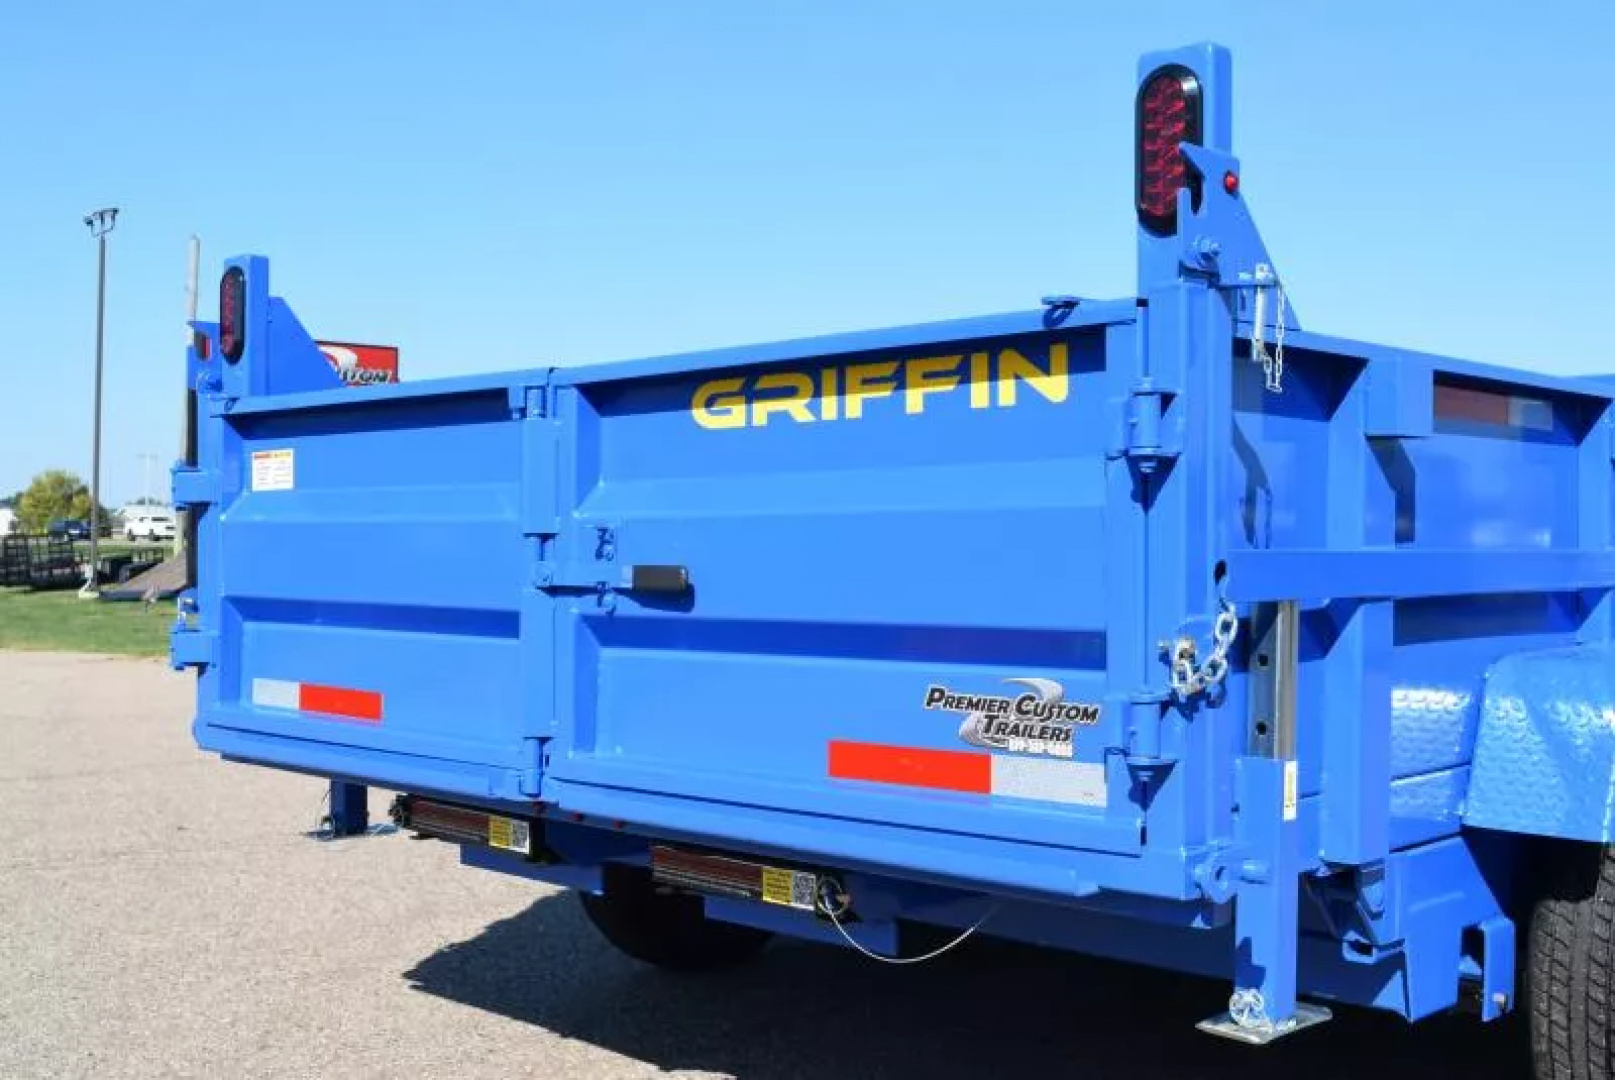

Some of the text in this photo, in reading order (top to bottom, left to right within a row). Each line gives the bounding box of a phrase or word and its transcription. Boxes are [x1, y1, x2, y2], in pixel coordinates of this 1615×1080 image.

[692, 343, 1069, 430] GRIFFIN
[924, 686, 1100, 723] PREMIER CUSTOM
[982, 714, 1073, 743] TRAILERS
